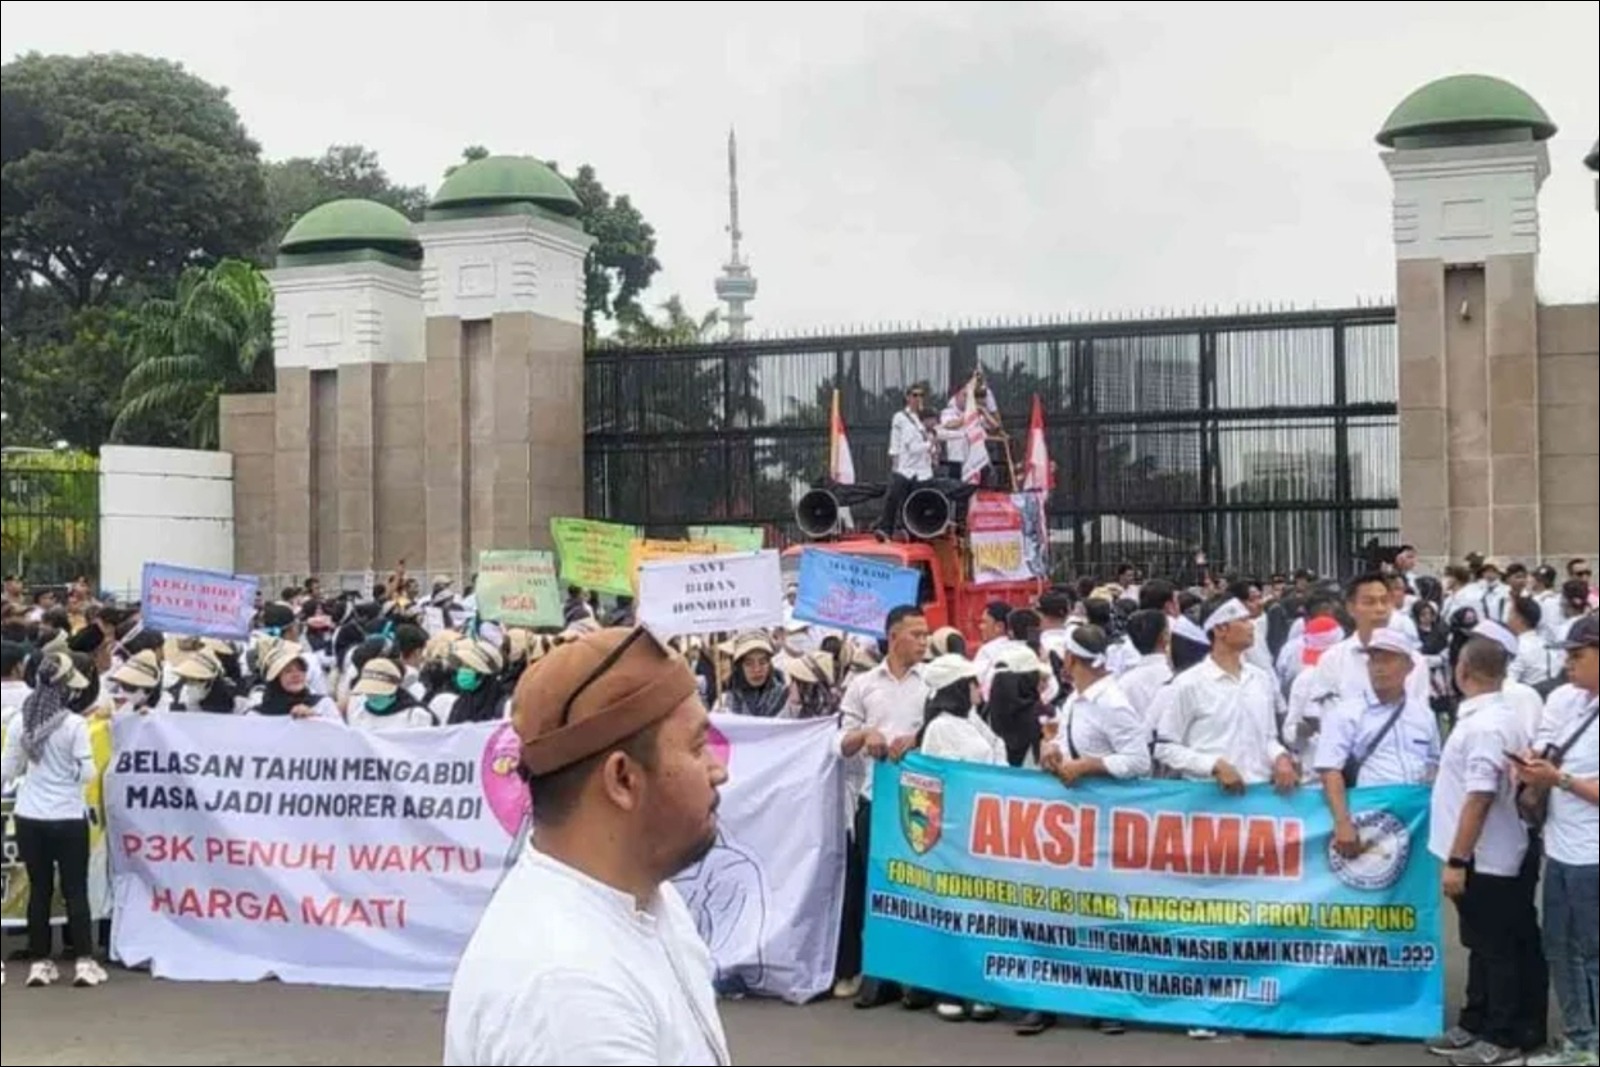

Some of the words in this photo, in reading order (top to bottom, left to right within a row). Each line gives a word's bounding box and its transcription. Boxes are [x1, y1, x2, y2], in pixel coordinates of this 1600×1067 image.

[115, 750, 244, 779] BELASAN
[252, 756, 337, 782] TAHUN
[342, 757, 474, 786] MENGABDI
[126, 785, 199, 812] MASA
[205, 789, 272, 815] JADI
[278, 792, 397, 818] HONORER
[402, 795, 483, 820] ABADI
[122, 834, 195, 863] P3K
[205, 836, 336, 872] PENUH
[348, 844, 482, 873] WAKTU
[969, 793, 1098, 870] AKSI
[1111, 808, 1302, 879] DAMAI
[151, 885, 289, 923] HARGA
[301, 894, 406, 929] MATI
[936, 871, 1018, 904] HONORER
[1022, 884, 1047, 910] R2
[1050, 889, 1075, 914] R3
[1079, 892, 1124, 919] KAB.
[1127, 895, 1250, 926] TANGGAMUS
[1256, 902, 1316, 929] PROV.
[1319, 905, 1416, 932] LAMPUNG
[871, 893, 930, 922] MENOLAK
[930, 905, 963, 932] PPPK
[967, 911, 1018, 939] PARUH
[1108, 931, 1173, 957] GIMANA
[1177, 937, 1228, 961] NASIB
[1232, 940, 1277, 961] KAMI
[985, 954, 1026, 979] PPPK
[1031, 958, 1082, 984] PENUH
[1086, 965, 1144, 992] WAKTU
[1148, 972, 1204, 997] HARGA
